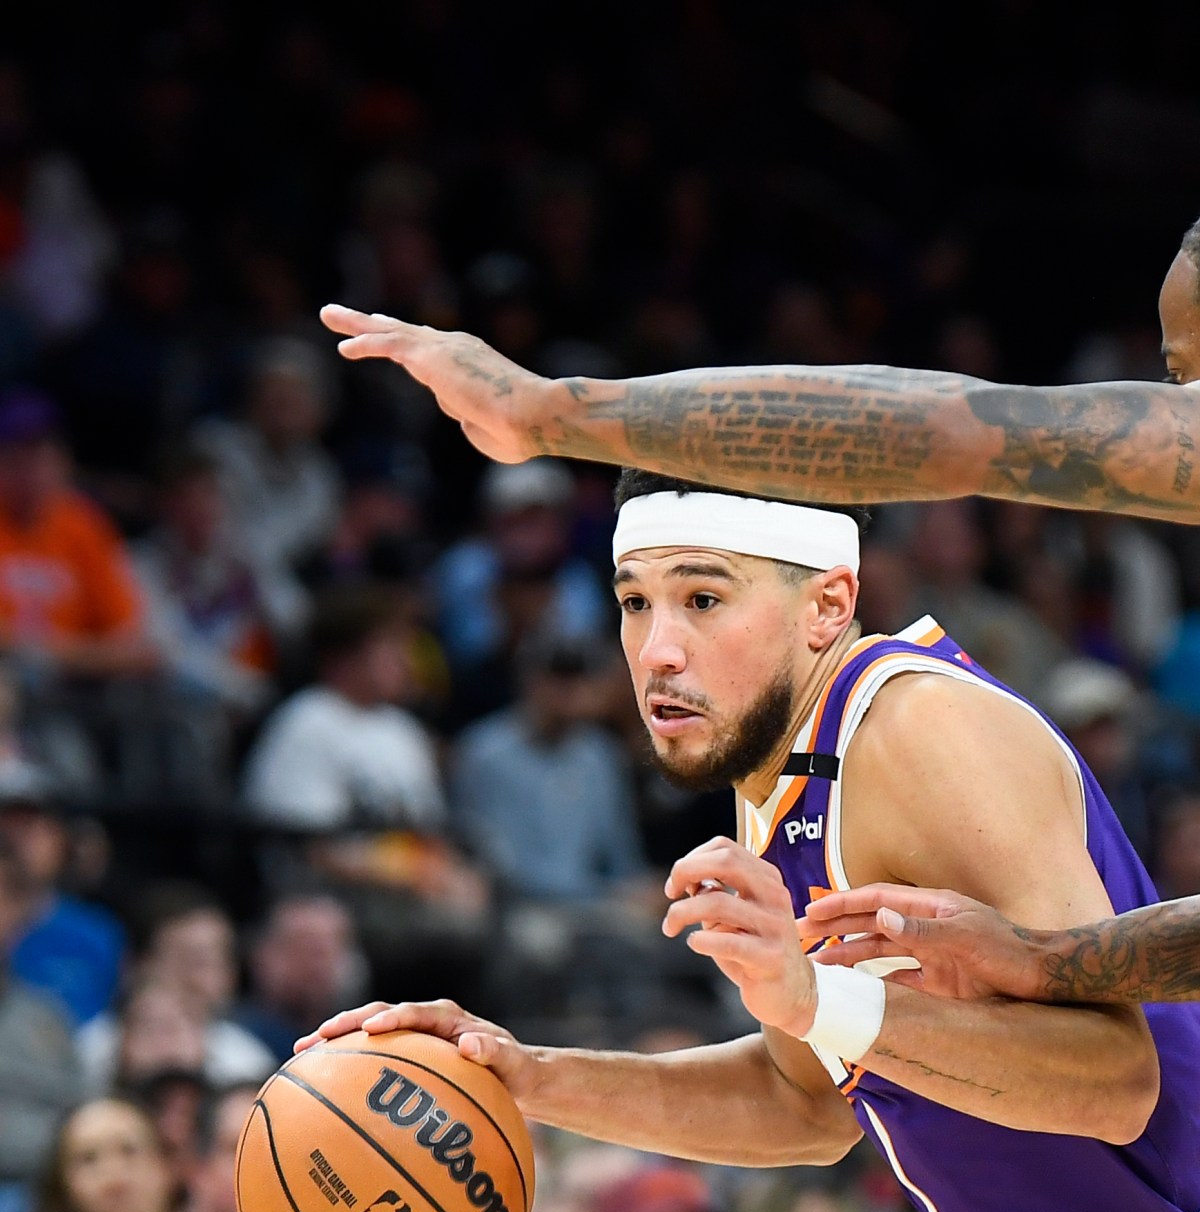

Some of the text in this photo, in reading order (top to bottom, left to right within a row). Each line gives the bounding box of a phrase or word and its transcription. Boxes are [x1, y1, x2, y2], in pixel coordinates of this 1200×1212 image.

[310, 1148, 358, 1209] OFFICIAL GAME BALL
